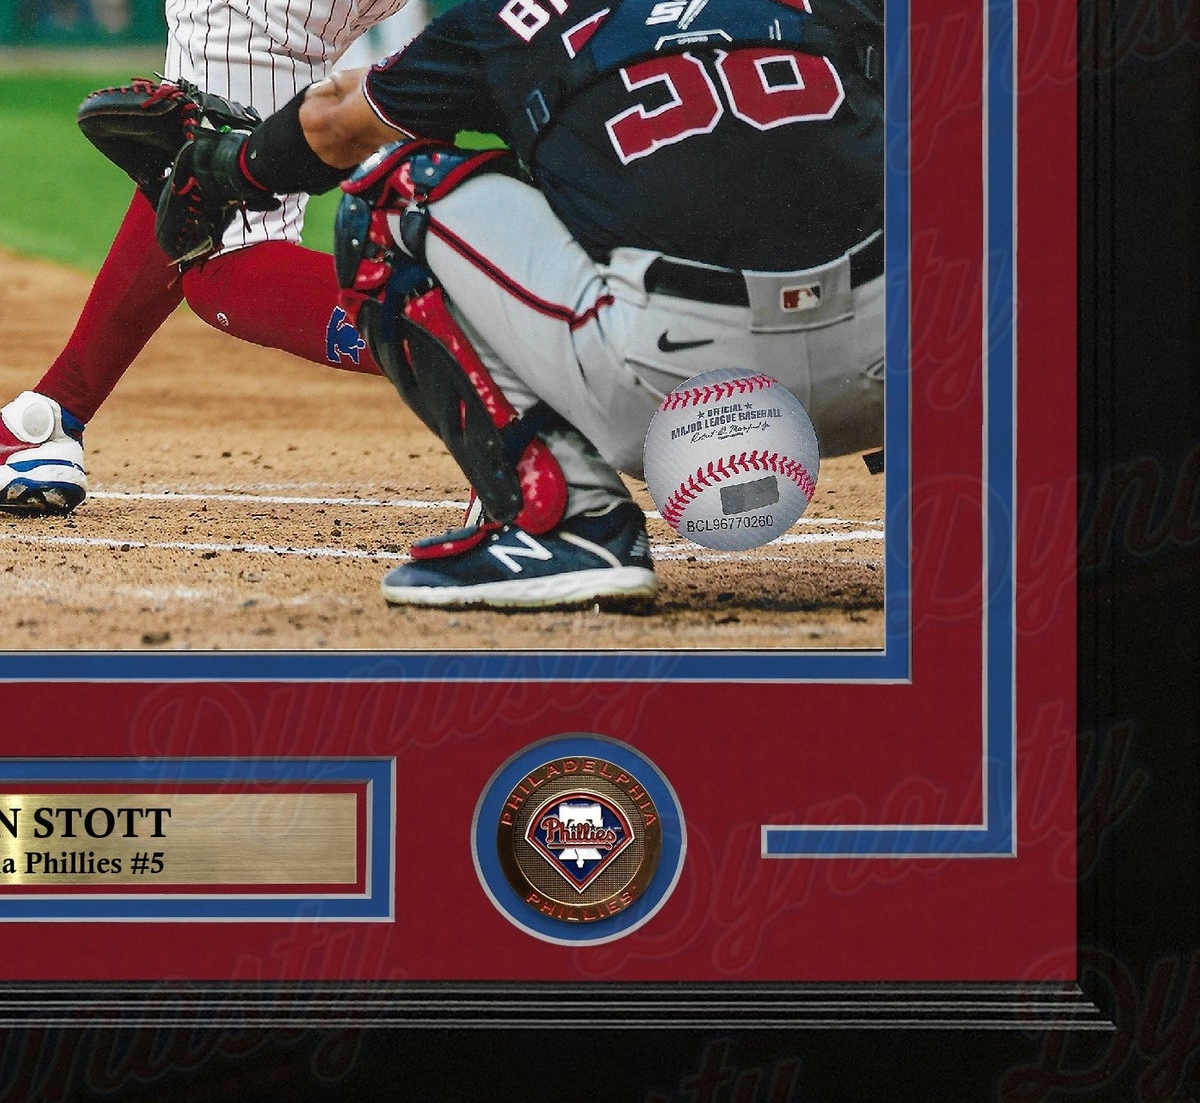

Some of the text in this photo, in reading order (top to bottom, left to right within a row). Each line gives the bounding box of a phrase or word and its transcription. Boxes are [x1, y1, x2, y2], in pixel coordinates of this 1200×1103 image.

[671, 421, 702, 440] MAJOR
[705, 413, 736, 428] LEAGUE
[738, 408, 782, 421] BASEBALL
[707, 404, 743, 417] OFFICIAL
[686, 514, 774, 533] BCL96770260
[500, 759, 657, 826] PHILADELPHIA
[33, 807, 172, 838] STOTT
[541, 815, 617, 844] Phillies
[24, 851, 122, 874] Phillies
[130, 851, 165, 875] #5
[526, 890, 634, 921] PHILLIES
